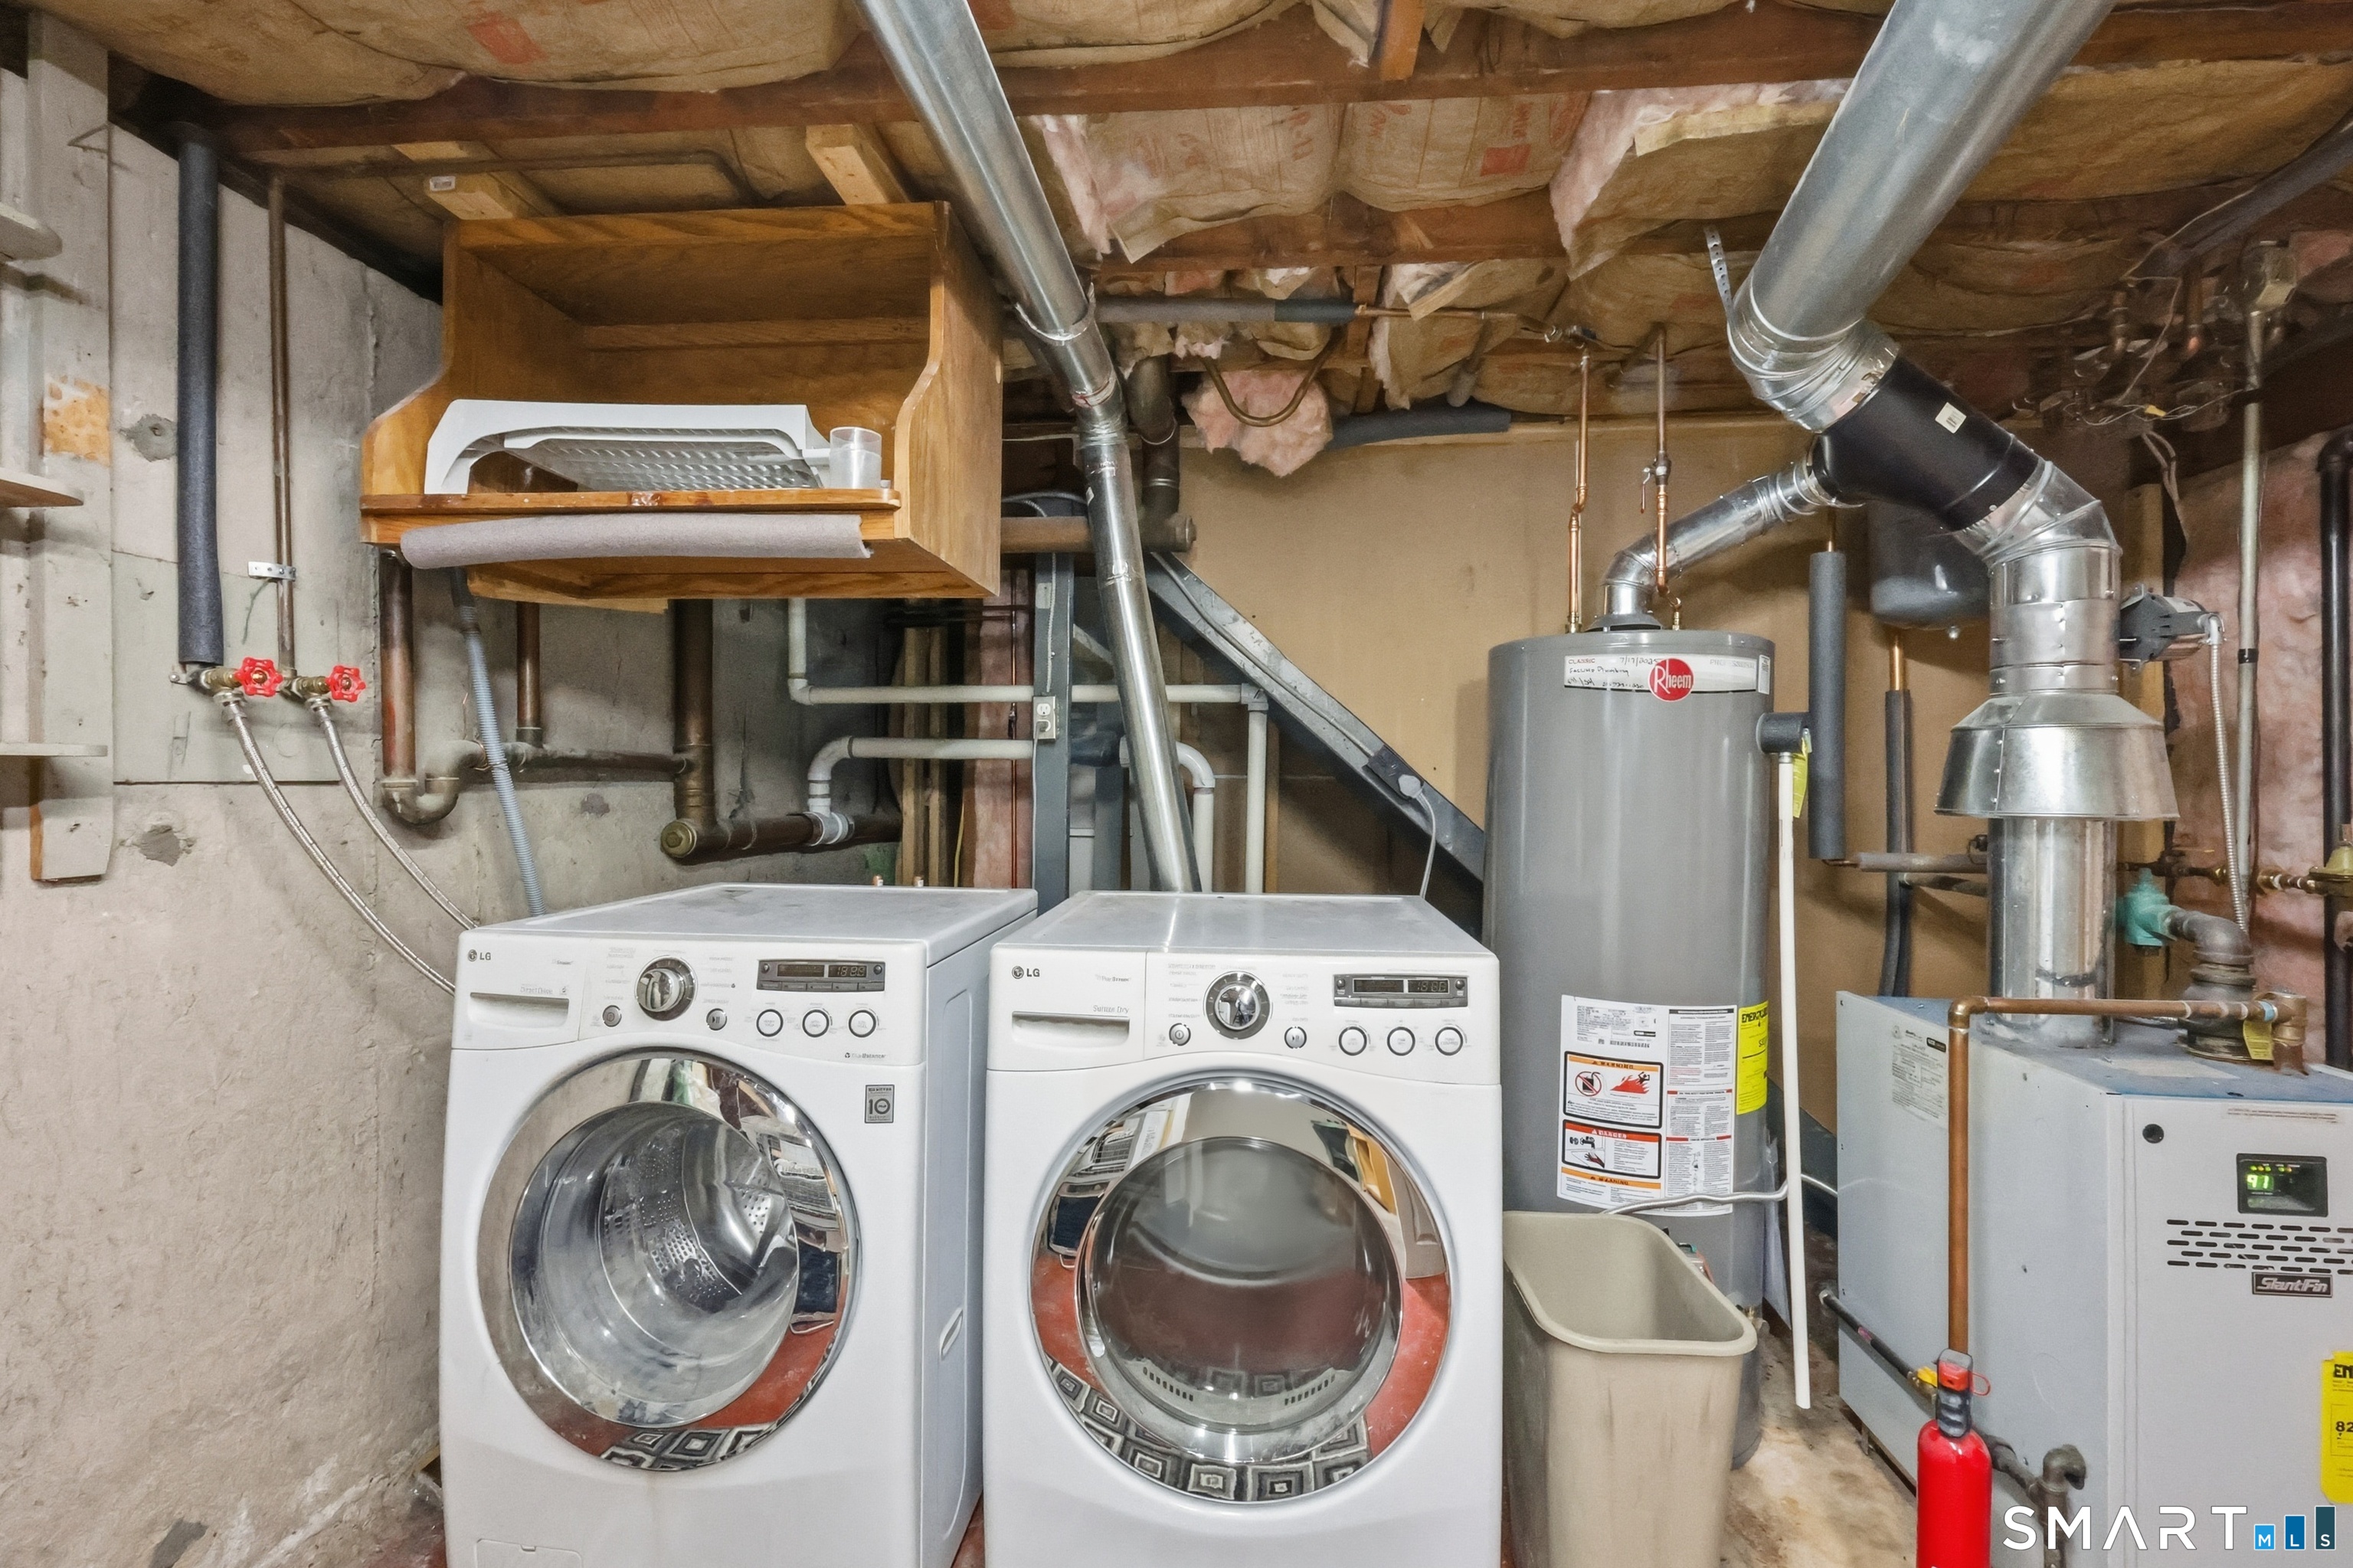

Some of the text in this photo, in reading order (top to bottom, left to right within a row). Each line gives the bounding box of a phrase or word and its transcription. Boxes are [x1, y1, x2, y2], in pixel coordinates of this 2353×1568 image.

[1653, 659, 1692, 695] Rheem
[479, 952, 492, 961] LG
[1026, 968, 1040, 977] LG
[1597, 1130, 1628, 1139] DANGER
